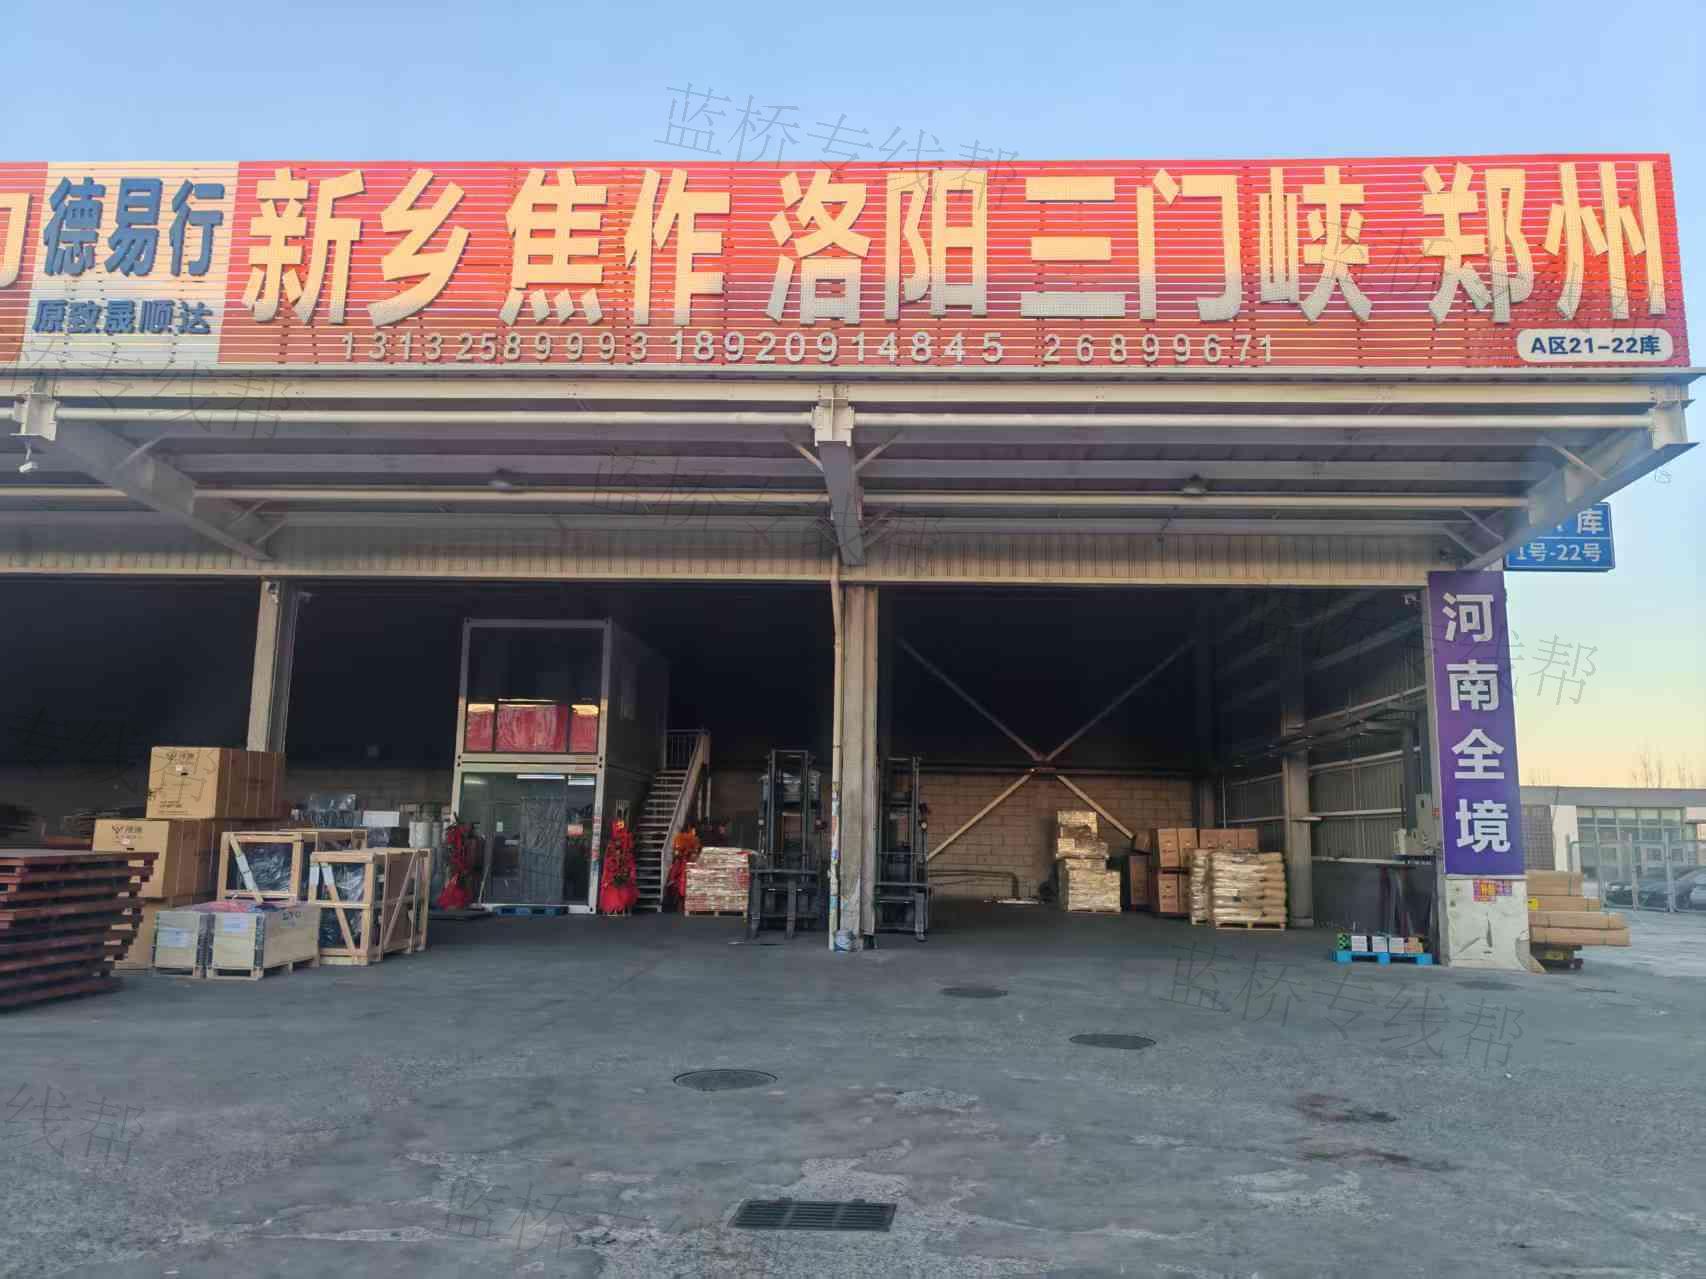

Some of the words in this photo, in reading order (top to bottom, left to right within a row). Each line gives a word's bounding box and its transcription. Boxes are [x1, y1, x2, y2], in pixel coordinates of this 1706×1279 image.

[43, 176, 225, 277] 德易行
[241, 167, 470, 327] 新乡
[499, 167, 731, 326] 焦作
[766, 168, 988, 325] 洛阳
[1019, 164, 1373, 325] 三门峡
[1419, 160, 1667, 324] 郑州
[341, 331, 648, 361] 13132589993
[669, 330, 1004, 363] 18920914845
[1042, 333, 1273, 363] 26899671
[1531, 336, 1661, 355] A区21-22库
[1441, 592, 1512, 855] 河南全境
